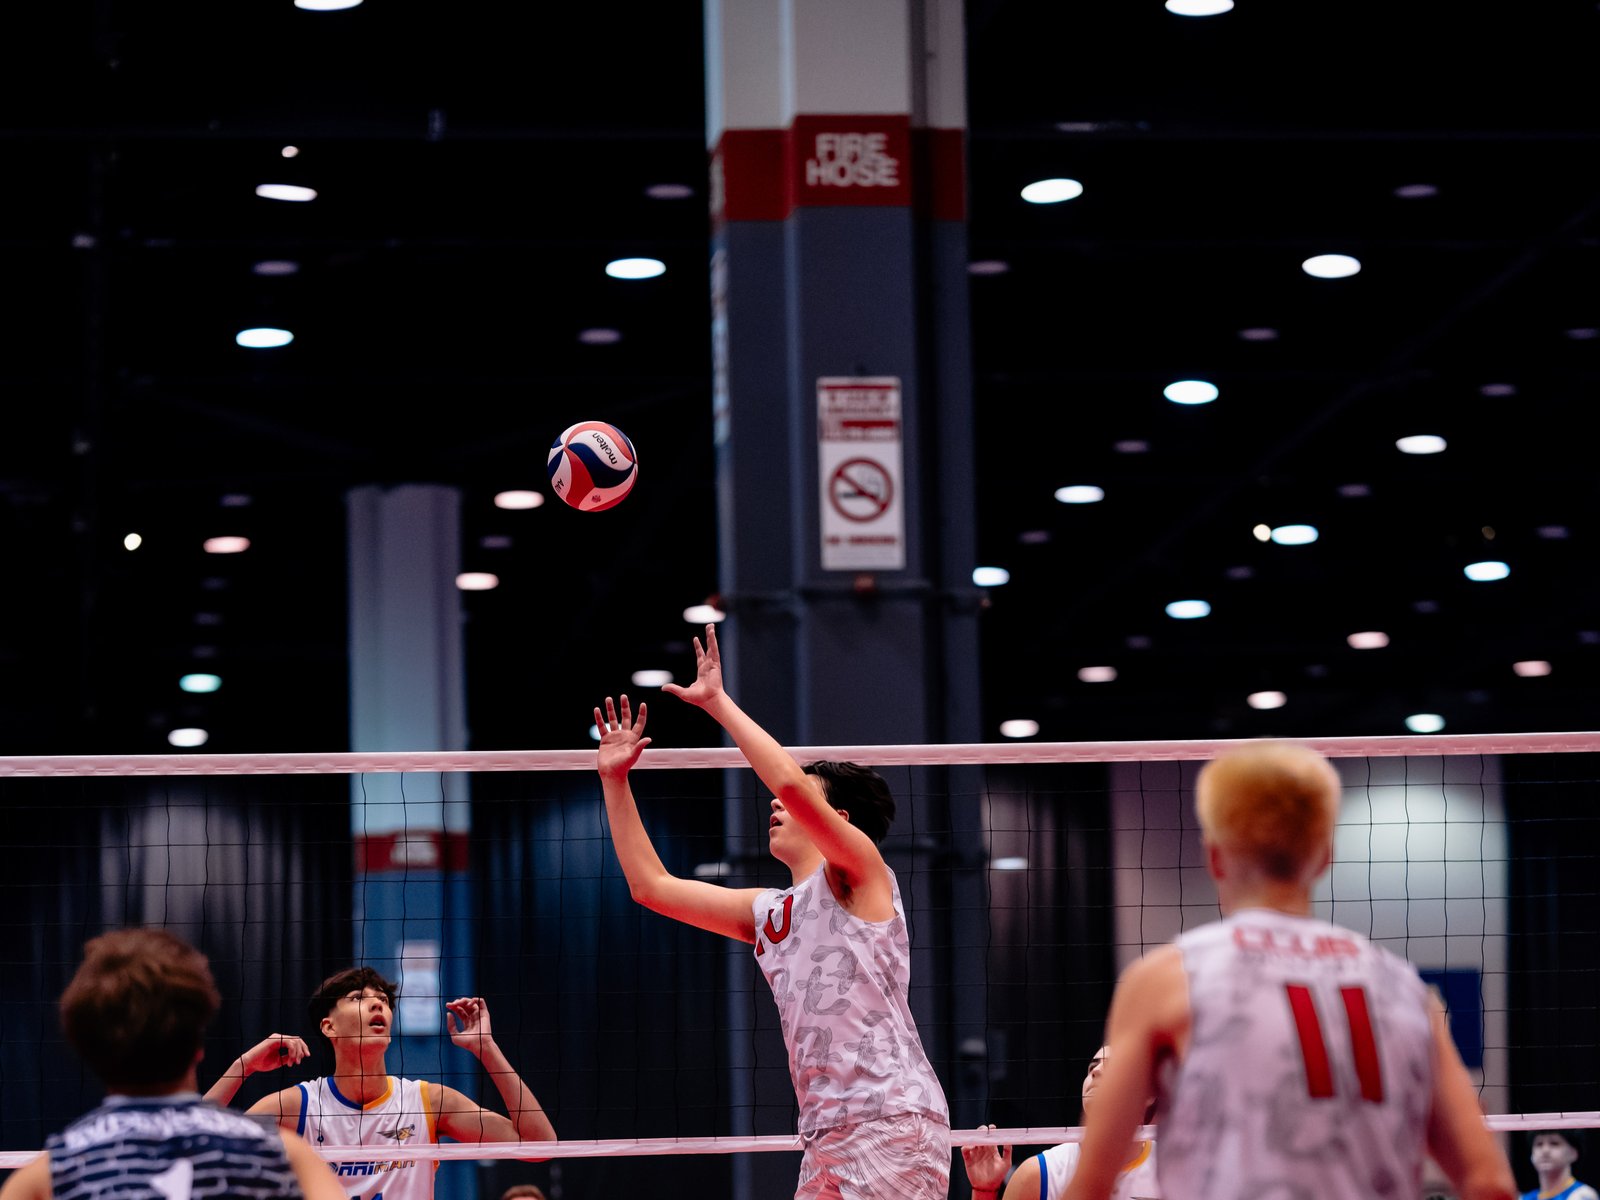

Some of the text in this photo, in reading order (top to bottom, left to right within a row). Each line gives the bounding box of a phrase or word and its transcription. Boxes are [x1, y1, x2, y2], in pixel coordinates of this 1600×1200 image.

[815, 132, 888, 162] FIRE
[806, 158, 899, 187] HOSE
[592, 432, 618, 465] molten
[1285, 982, 1386, 1105] 11
